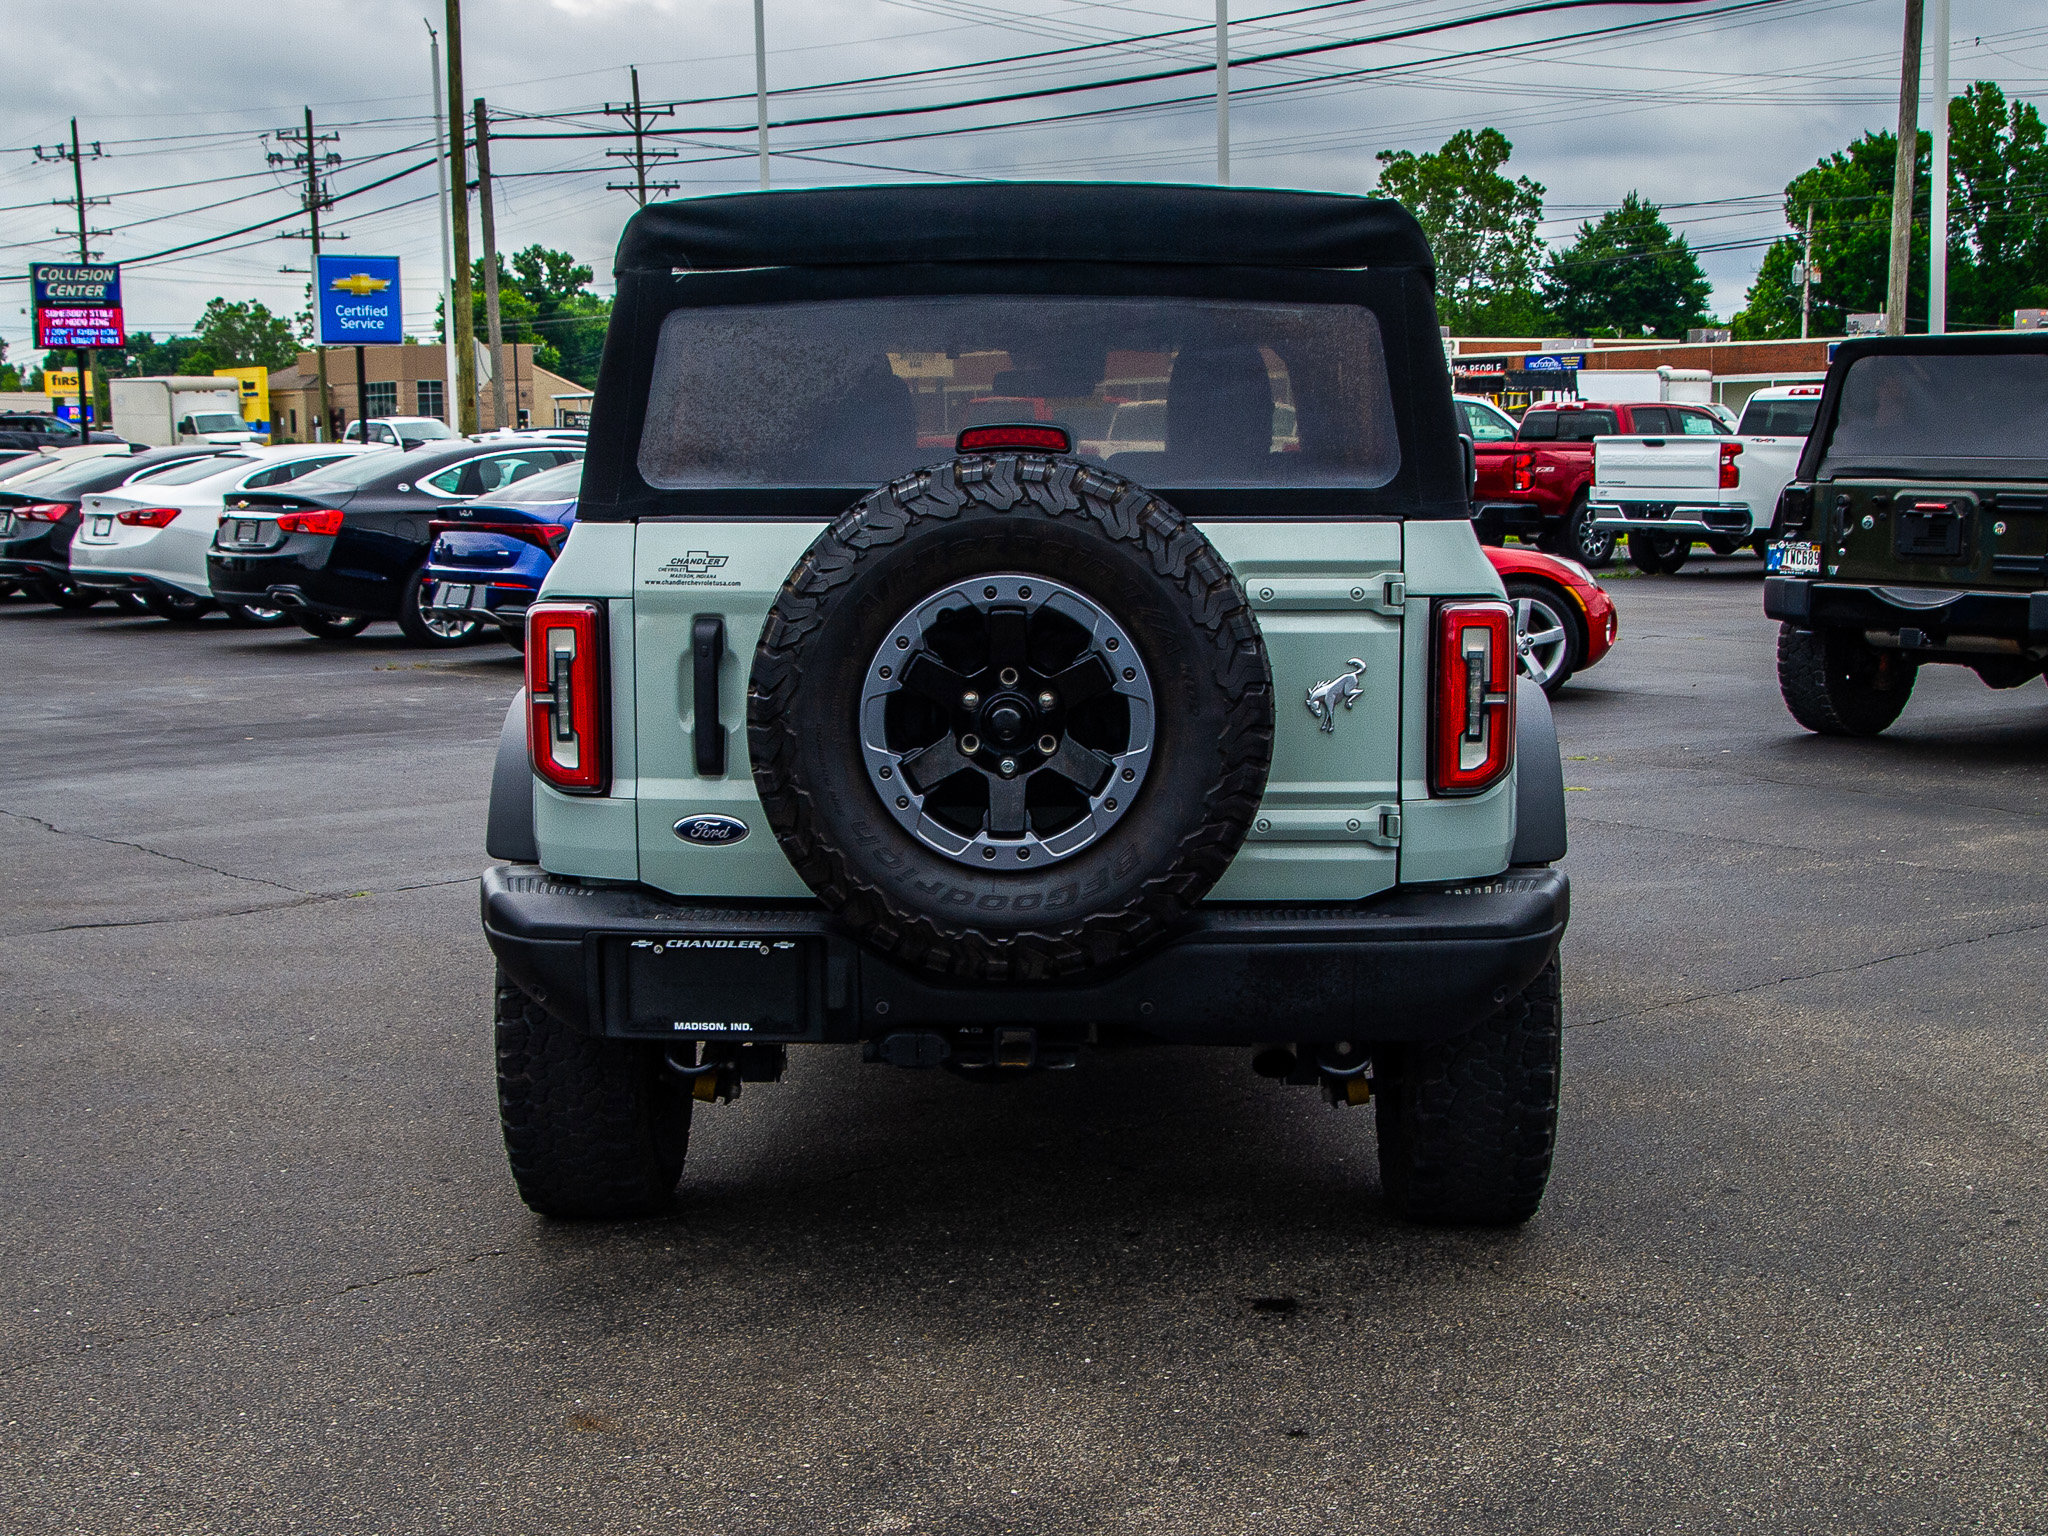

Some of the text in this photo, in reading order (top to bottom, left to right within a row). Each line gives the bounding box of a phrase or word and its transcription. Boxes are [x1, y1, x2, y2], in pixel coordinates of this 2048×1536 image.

[38, 267, 114, 281] COLLISION
[46, 283, 105, 296] CENTER
[335, 304, 389, 317] Certified
[340, 317, 385, 329] Service
[670, 557, 721, 565] CHANDLER
[644, 579, 742, 587] www.chandlerchevroletusa.com
[690, 820, 731, 839] Ford
[665, 939, 762, 949] CHANDLER
[730, 1022, 753, 1031] IND.
